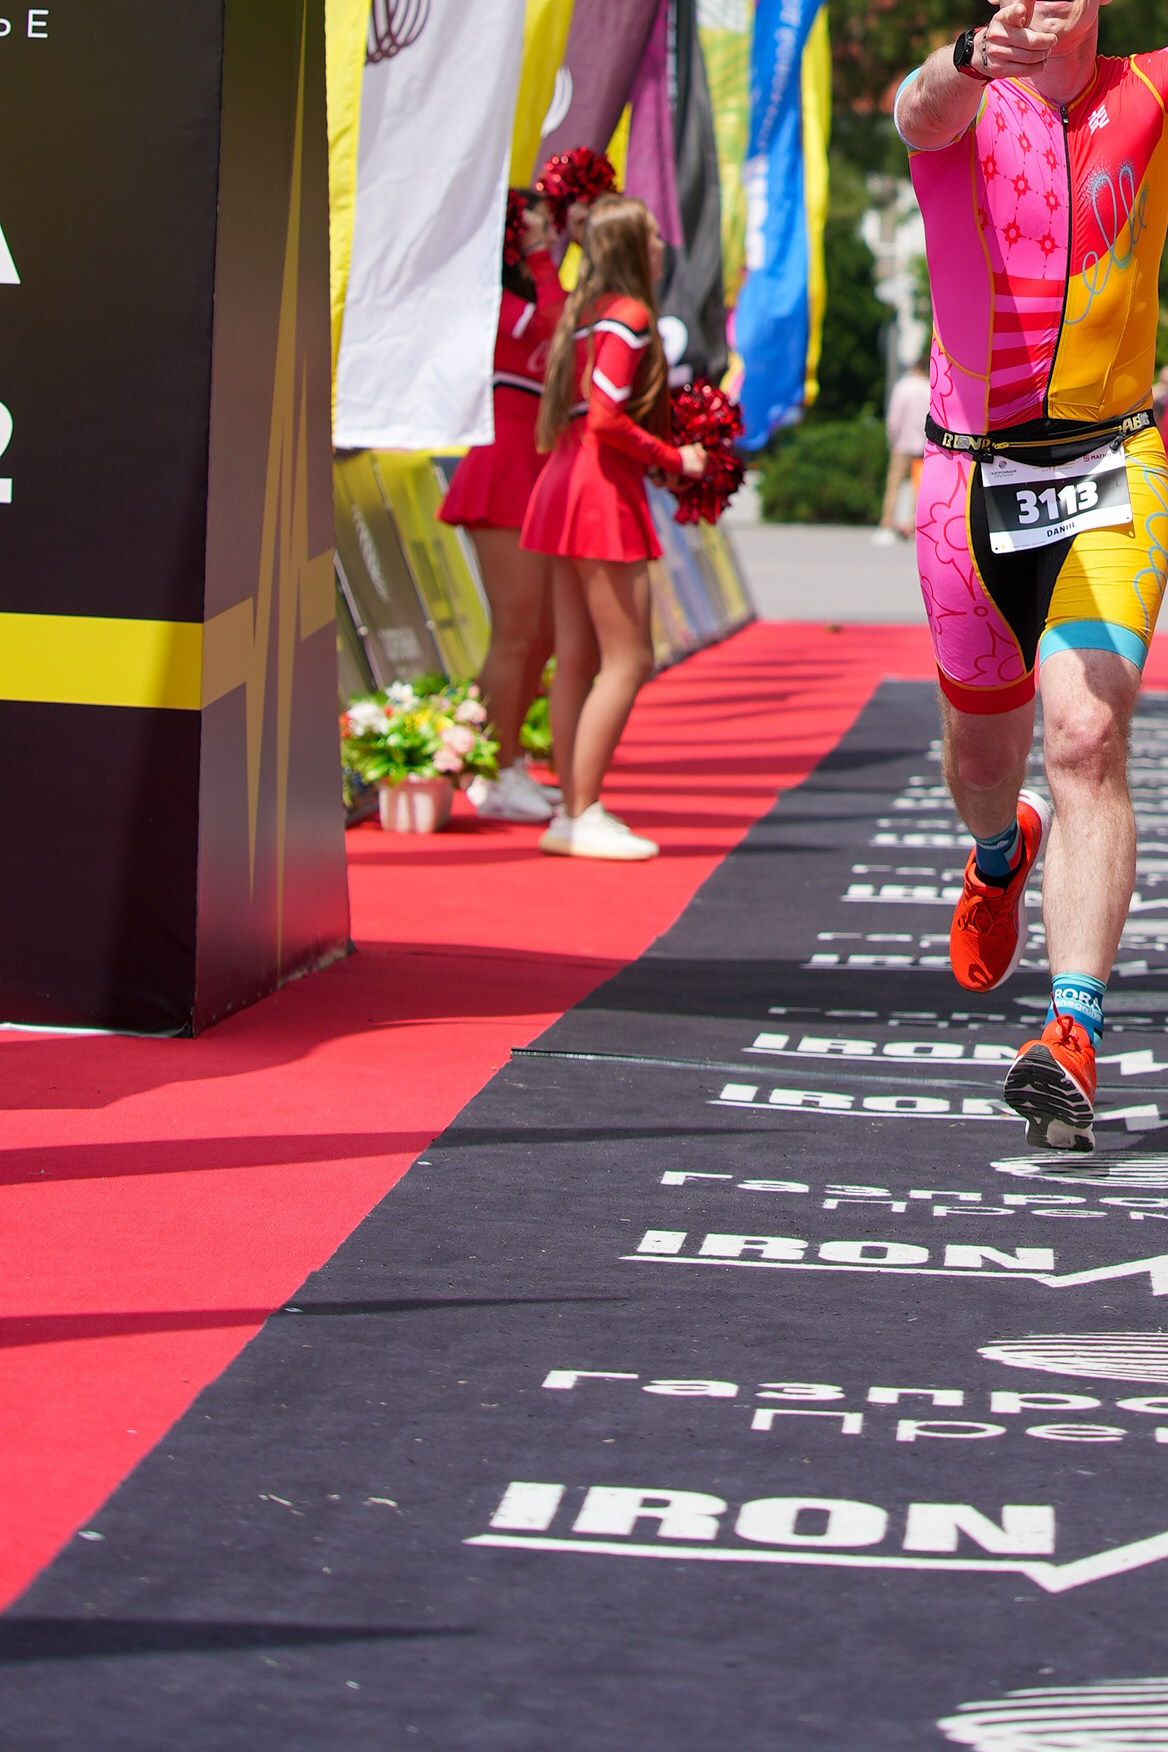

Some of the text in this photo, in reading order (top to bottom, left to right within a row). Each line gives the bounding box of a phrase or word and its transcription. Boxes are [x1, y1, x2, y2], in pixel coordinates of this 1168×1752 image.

[1016, 481, 1099, 524] 3113
[1054, 988, 1102, 1012] BORA
[636, 1230, 1055, 1270] IRON
[489, 1481, 1056, 1555] IRON
